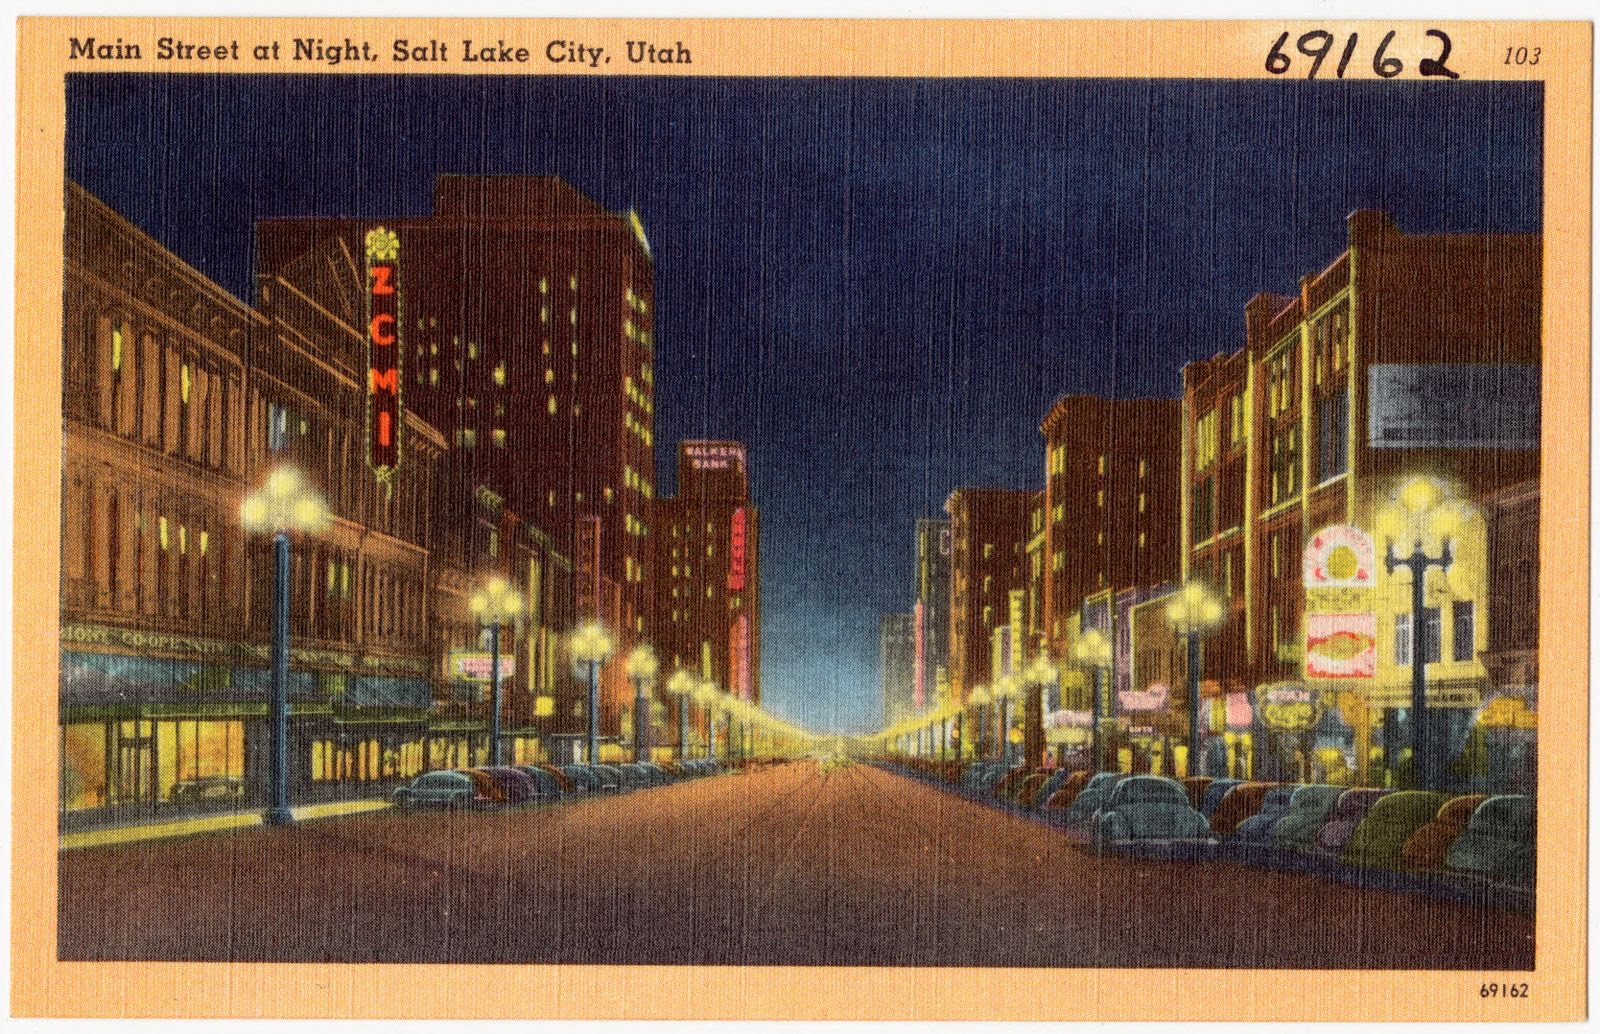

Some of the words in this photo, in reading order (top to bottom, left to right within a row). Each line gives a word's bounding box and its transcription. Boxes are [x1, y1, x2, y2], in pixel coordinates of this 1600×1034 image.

[70, 38, 141, 59] Main
[157, 38, 238, 61] Street
[254, 41, 280, 61] at
[293, 38, 380, 65] Night,
[393, 39, 447, 62] Salt
[463, 40, 529, 63] Lake
[546, 41, 611, 67] City,
[626, 42, 692, 64] Utah
[1265, 29, 1460, 80] 69162
[1504, 46, 1542, 66] 103
[1480, 983, 1529, 998] 69162
